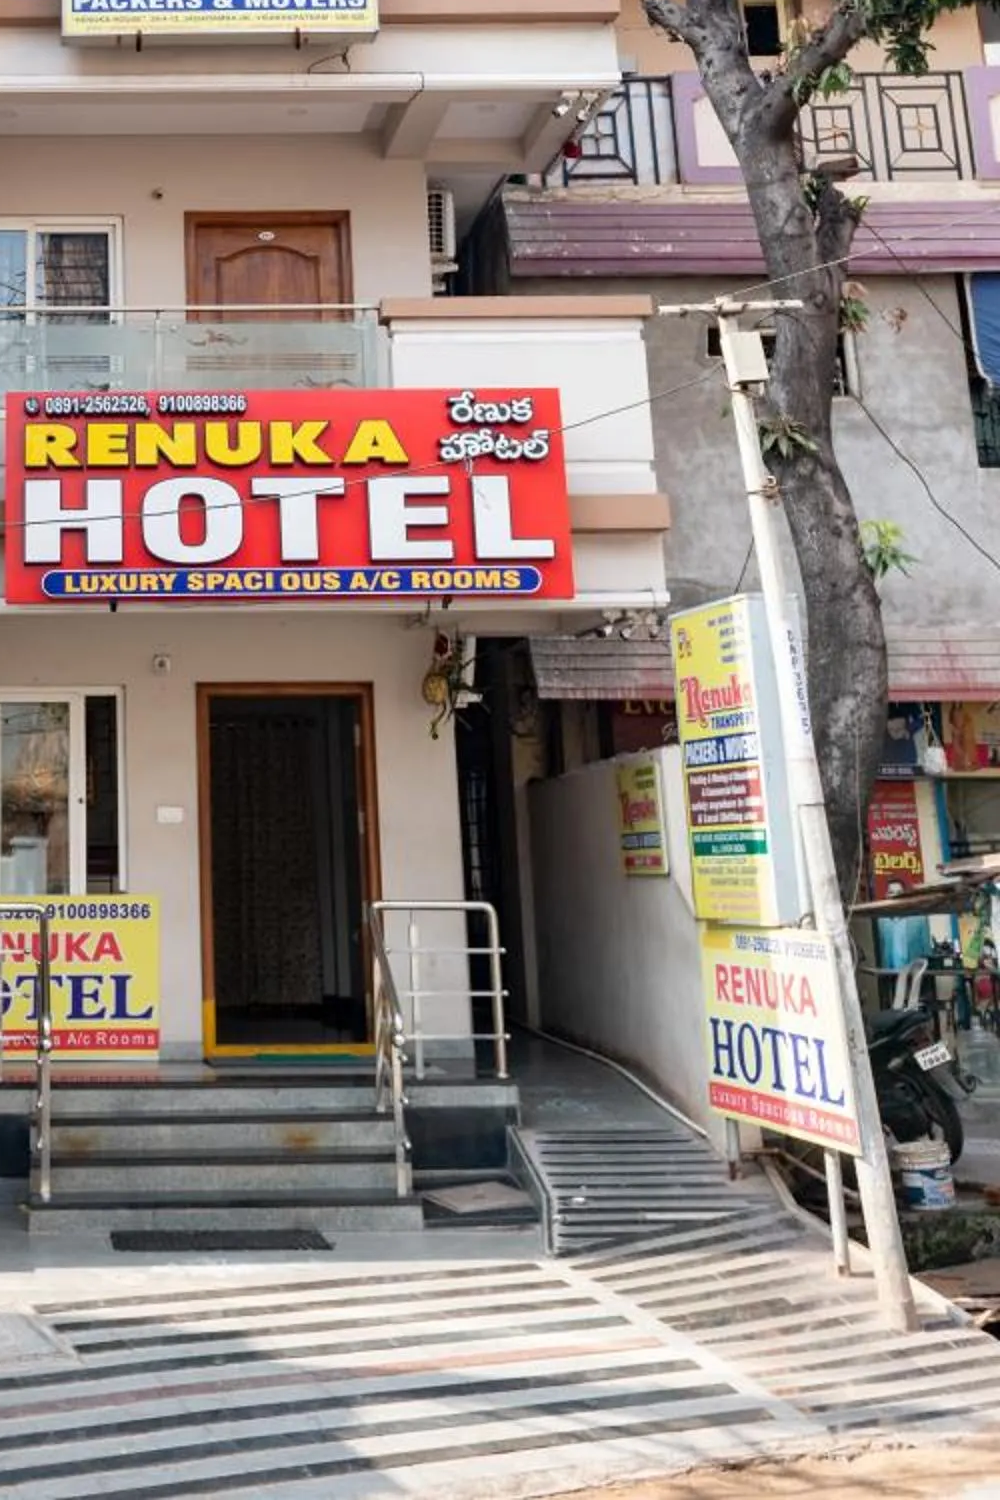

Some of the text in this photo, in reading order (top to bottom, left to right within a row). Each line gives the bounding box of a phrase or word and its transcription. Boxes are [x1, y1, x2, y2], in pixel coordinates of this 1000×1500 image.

[45, 395, 247, 415] 0891-2562526, 9100898366
[448, 390, 533, 423] రేణుక
[24, 420, 409, 468] RENUKA
[23, 475, 555, 563] HOTEL
[64, 573, 177, 593] LUXURY
[350, 571, 401, 591] A/C
[411, 570, 520, 589] ROOMS
[46, 903, 151, 920] 9100898366
[715, 963, 818, 1019] RENUKA
[66, 1031, 91, 1047] A/c
[96, 1031, 156, 1046] Rooms
[709, 1016, 845, 1108] HOTEL
